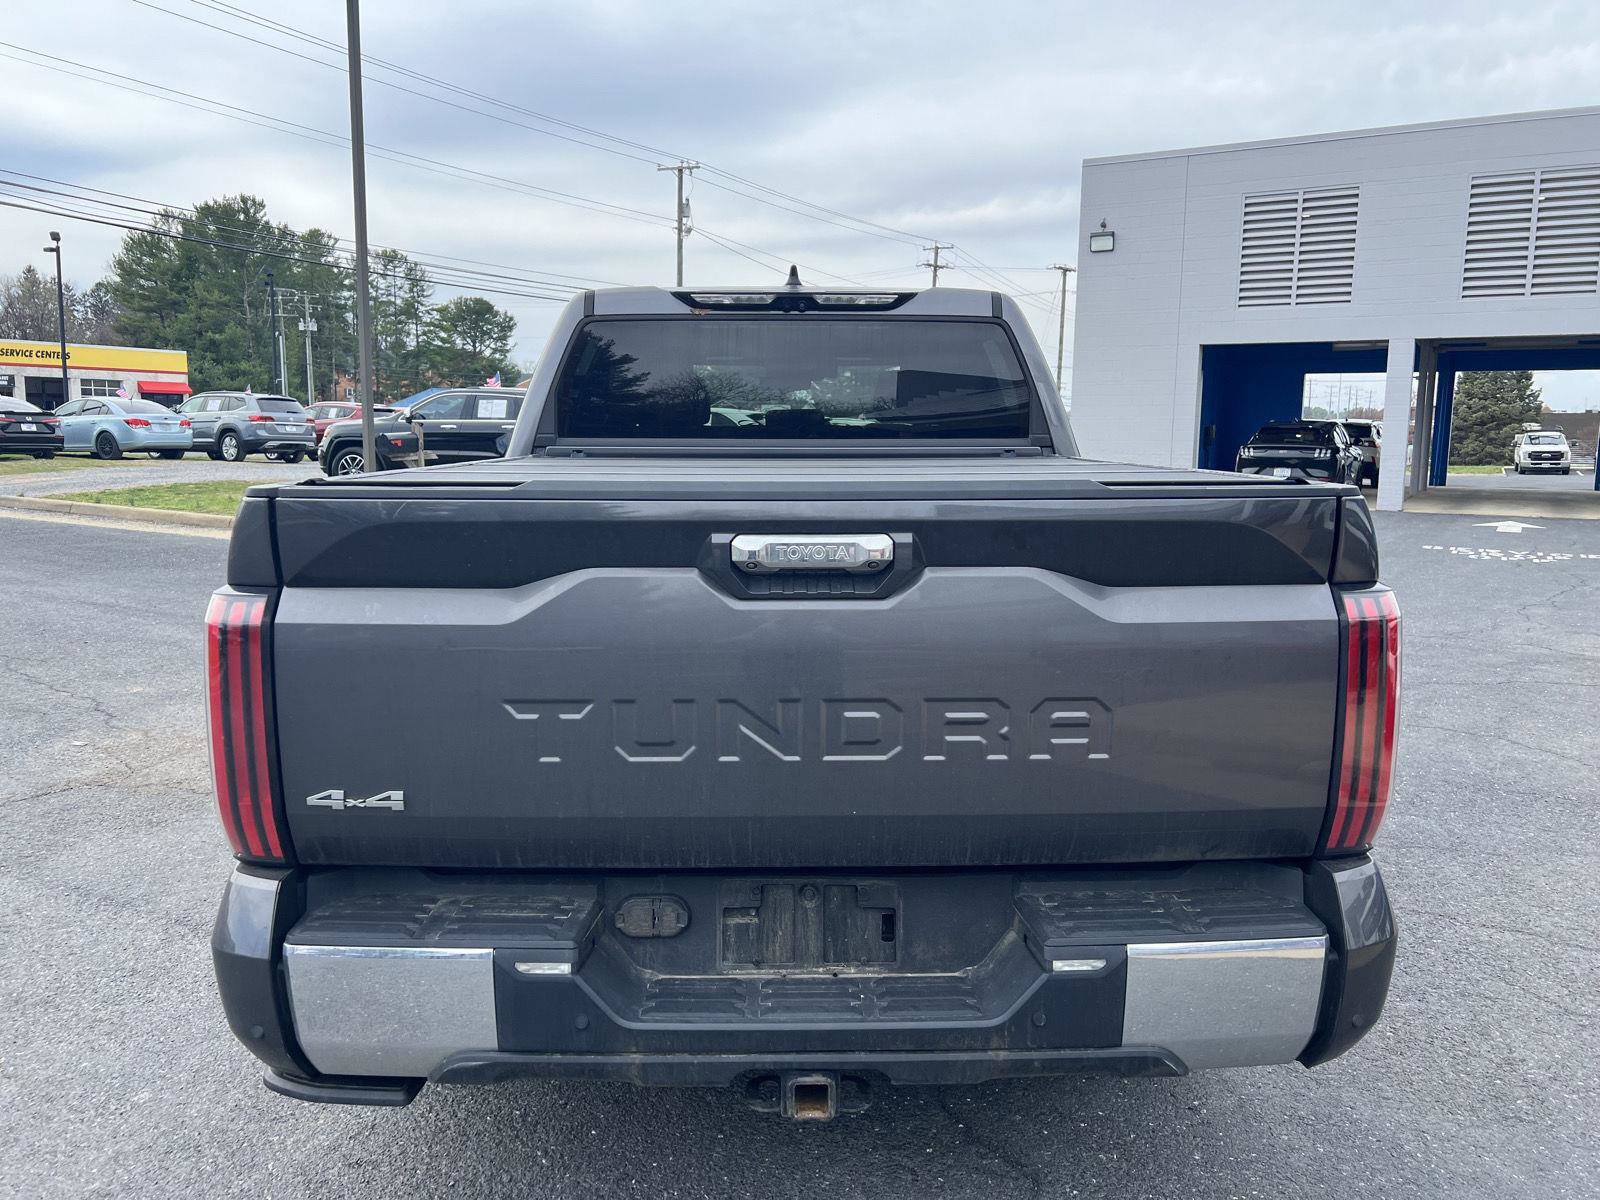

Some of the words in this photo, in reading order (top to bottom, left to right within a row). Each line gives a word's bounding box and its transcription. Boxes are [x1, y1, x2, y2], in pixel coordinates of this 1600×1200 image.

[0, 348, 34, 358] SERVICE
[35, 350, 71, 360] CENTES
[775, 545, 850, 560] TOYOTA
[501, 697, 1113, 763] TUNDRA
[306, 789, 405, 811] 4x4
